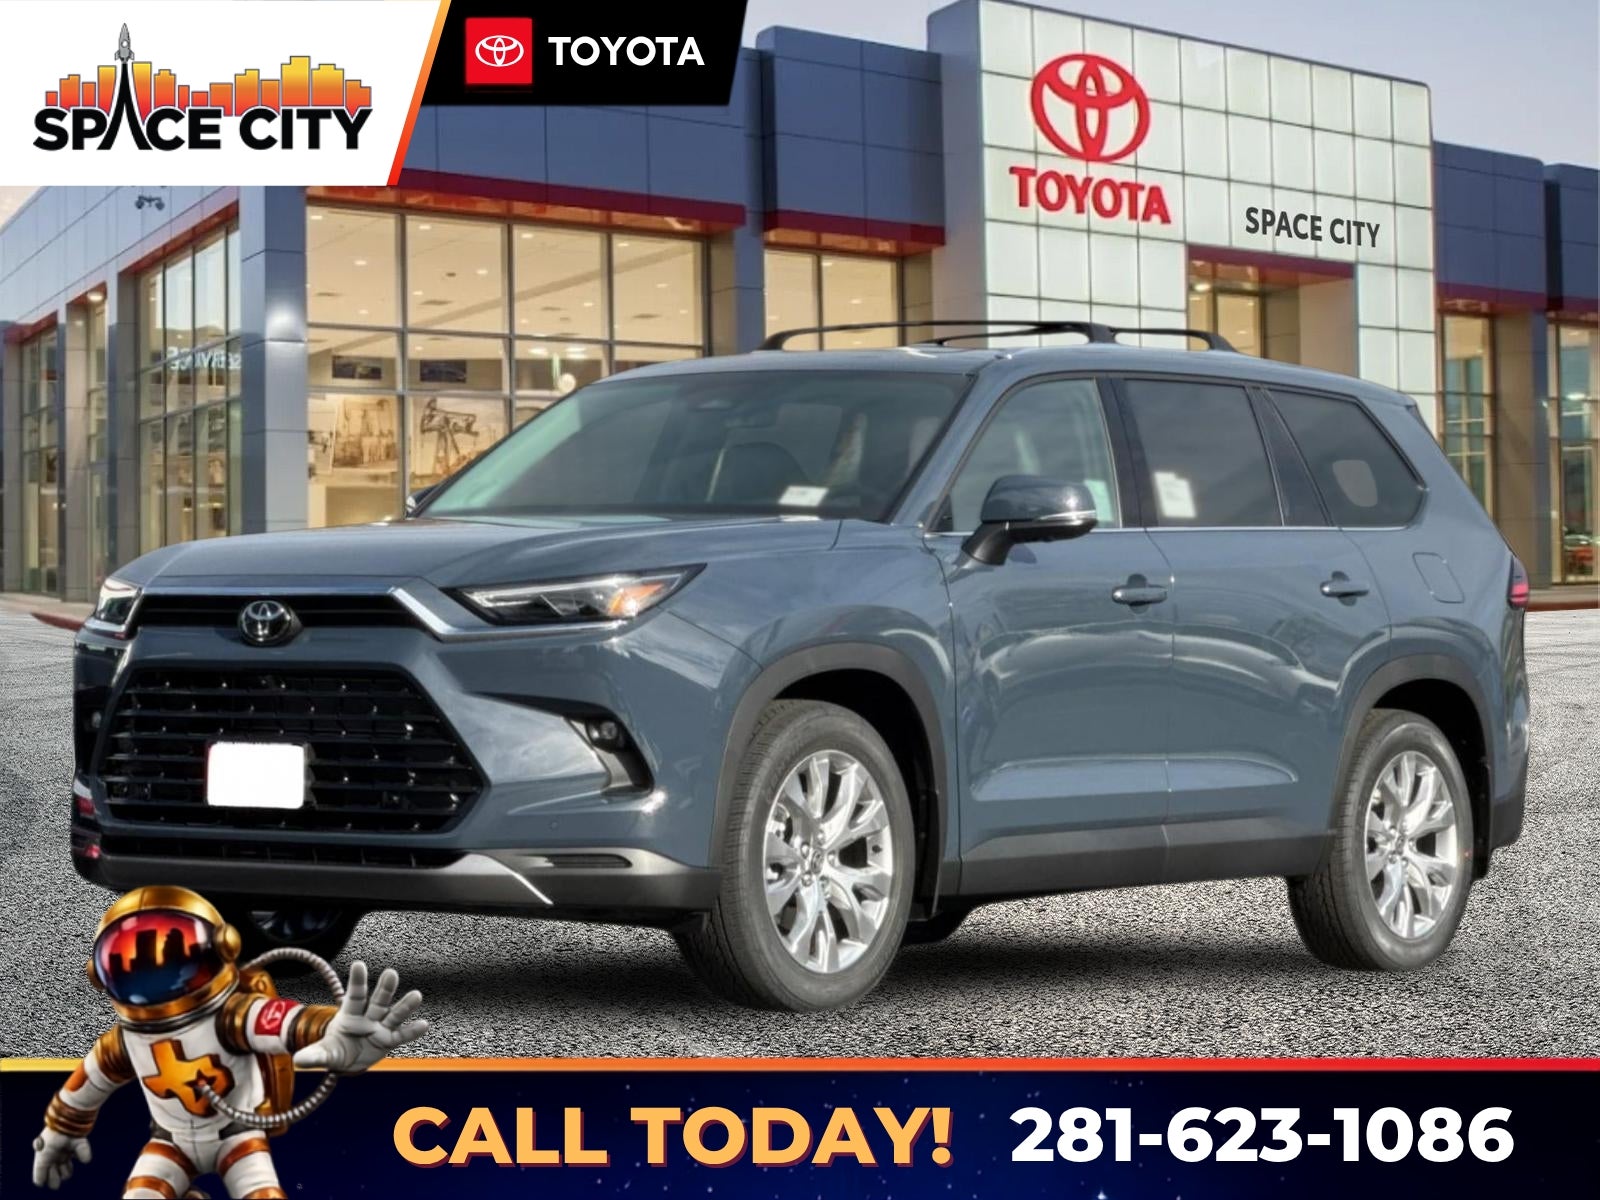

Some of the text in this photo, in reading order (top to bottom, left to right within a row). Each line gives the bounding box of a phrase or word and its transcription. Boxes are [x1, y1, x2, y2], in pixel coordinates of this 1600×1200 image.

[1009, 166, 1171, 224] TOYOTA
[1245, 206, 1380, 248] SPACE CITY
